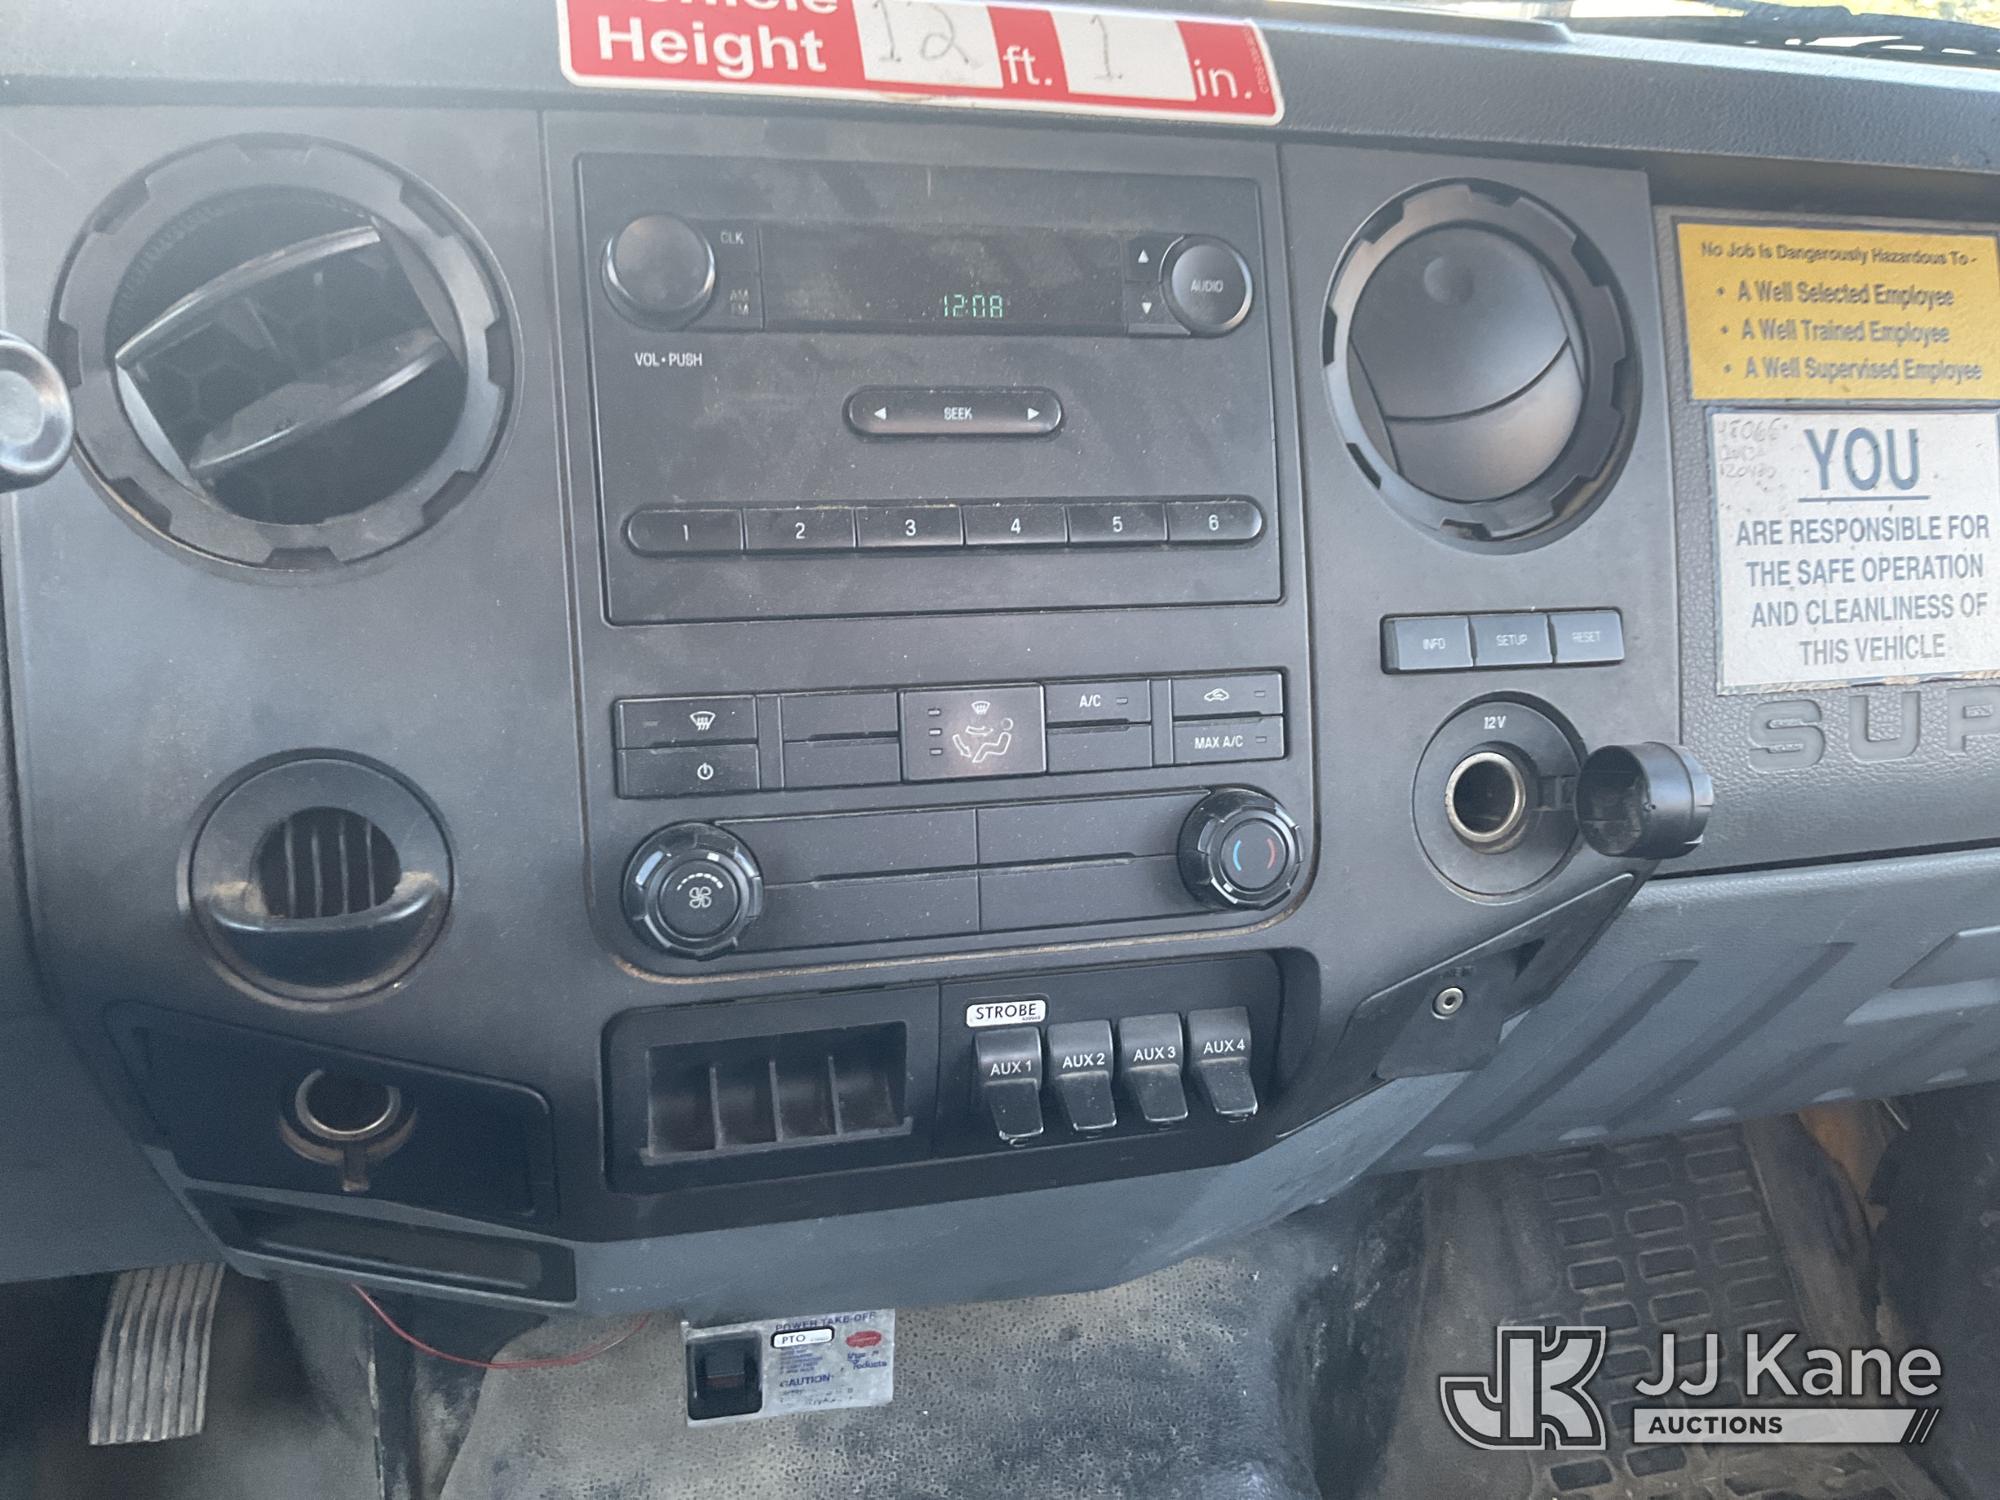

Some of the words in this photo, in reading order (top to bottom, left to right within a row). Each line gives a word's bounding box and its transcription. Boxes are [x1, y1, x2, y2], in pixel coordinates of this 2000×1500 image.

[874, 1, 973, 64] 12
[597, 15, 827, 79] Height
[1090, 14, 1121, 81] 1
[1003, 45, 1053, 86] ft.
[1194, 59, 1253, 99] in.
[720, 231, 744, 245] CLK
[1702, 241, 1722, 258] No
[1727, 242, 1755, 259] Job
[1776, 244, 1868, 265] Dangerously
[1871, 247, 1946, 265] Hazardous
[1949, 250, 1969, 266] To
[1190, 279, 1224, 293] AUDIO
[1738, 280, 1752, 302] A
[1756, 281, 1793, 302] Well
[1797, 282, 1870, 305] Selected
[1874, 284, 1954, 311] Employee
[942, 294, 1003, 318] 12:08
[1741, 318, 1755, 341] A
[1759, 319, 1798, 341] Well
[1801, 320, 1865, 342] Trained
[1869, 321, 1950, 348] Employee
[1745, 356, 1759, 378] A
[1763, 357, 1800, 379] Well
[1804, 358, 1898, 383] Supervised
[1904, 359, 1982, 385] Employee
[943, 407, 973, 421] SEEK
[1803, 427, 1919, 491] YOU
[795, 522, 806, 540] 2
[905, 519, 917, 536] 3
[1010, 518, 1021, 534] 4
[1112, 516, 1123, 532] 5
[1208, 514, 1219, 531] 6
[1736, 519, 1783, 546] ARE
[1790, 515, 1942, 545] RESPONSIBLE
[1948, 514, 1989, 540] FOR
[682, 524, 689, 543] 1
[1746, 560, 1791, 587] THE
[1798, 558, 1855, 585] SAFE
[1861, 553, 1984, 583] OPERATION
[1751, 602, 1798, 628] AND
[1806, 595, 1954, 626] CLEANLINESS
[1960, 592, 1987, 618] OF
[1422, 639, 1446, 650] INFO
[1496, 634, 1528, 647] SETUP
[1572, 631, 1600, 643] RESET
[1799, 638, 1849, 665] THIS
[1854, 634, 1945, 662] VEHICLE
[1079, 694, 1101, 708] A/C
[1484, 716, 1506, 729] 12V
[1194, 735, 1220, 749] MAX
[1222, 734, 1243, 748] A/C
[976, 1003, 1037, 1019] STROBE
[1133, 1049, 1165, 1062] AUX
[1167, 1046, 1176, 1059] 3
[1203, 1041, 1235, 1055] AUX
[1237, 1039, 1246, 1051] 4
[990, 1062, 1022, 1076] AUX
[1025, 1062, 1033, 1072] 1
[1062, 1055, 1095, 1069] AUX
[1097, 1053, 1105, 1065] 2
[782, 1334, 806, 1345] PTO
